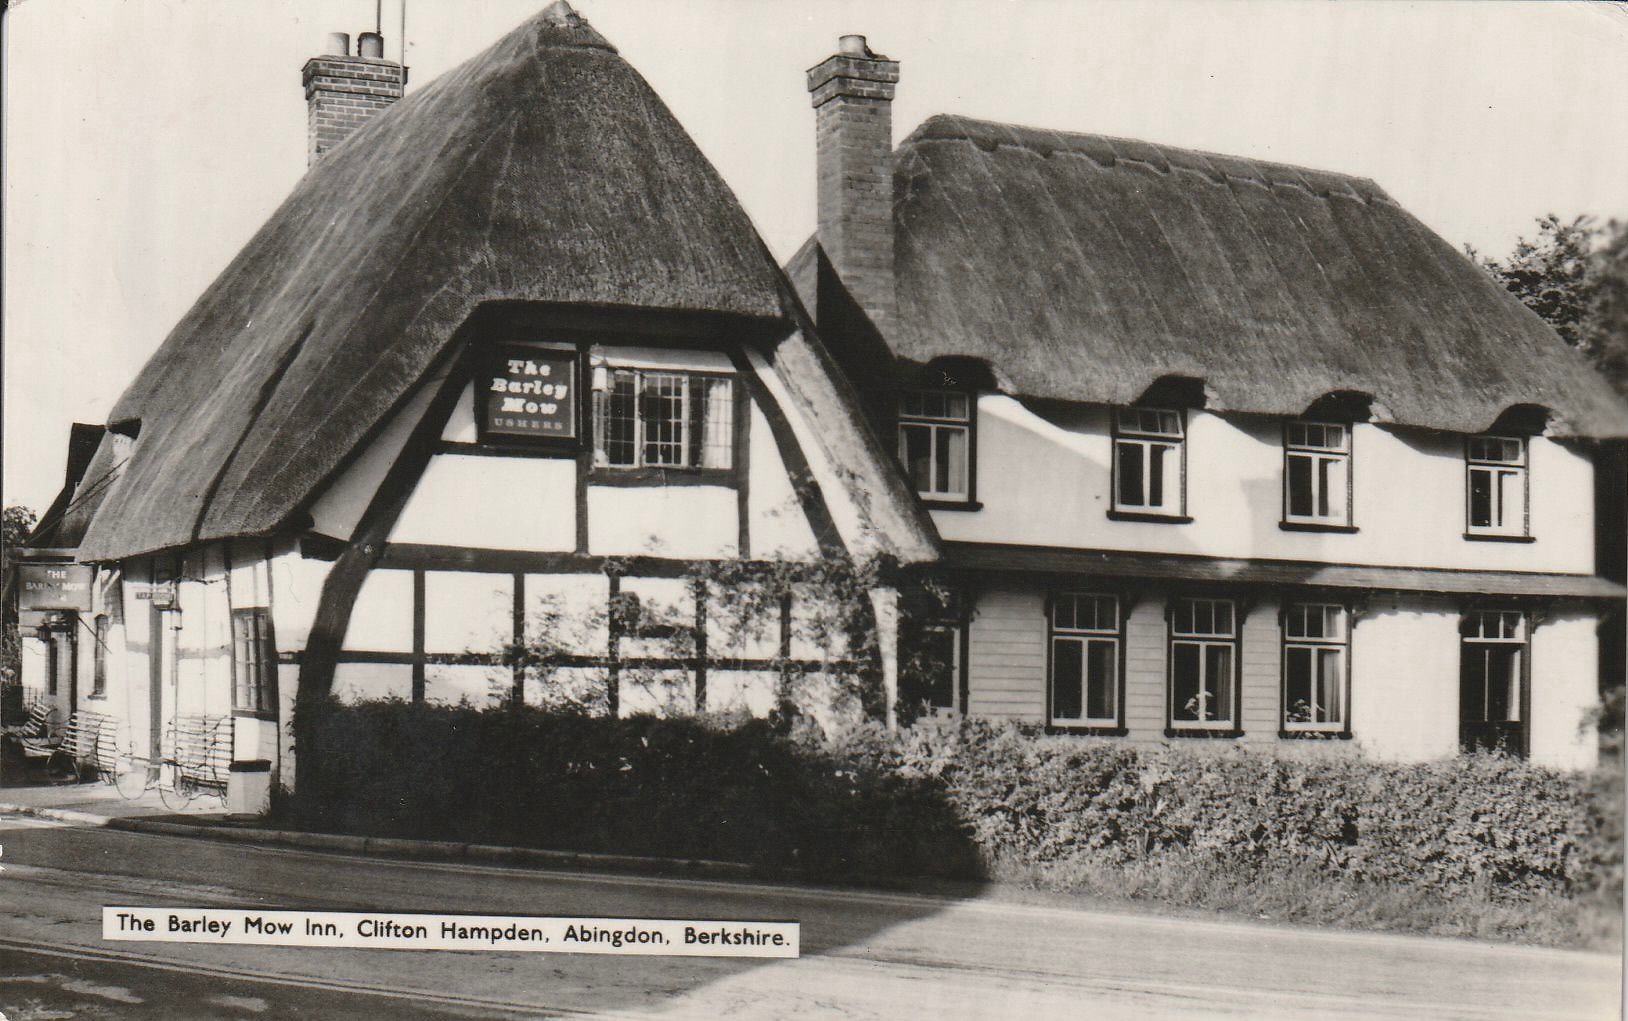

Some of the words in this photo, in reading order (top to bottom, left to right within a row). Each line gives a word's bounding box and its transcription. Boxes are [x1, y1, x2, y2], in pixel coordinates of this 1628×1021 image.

[507, 359, 552, 377] The
[490, 377, 568, 400] Barley
[501, 396, 558, 415] Mow
[47, 569, 67, 579] THE
